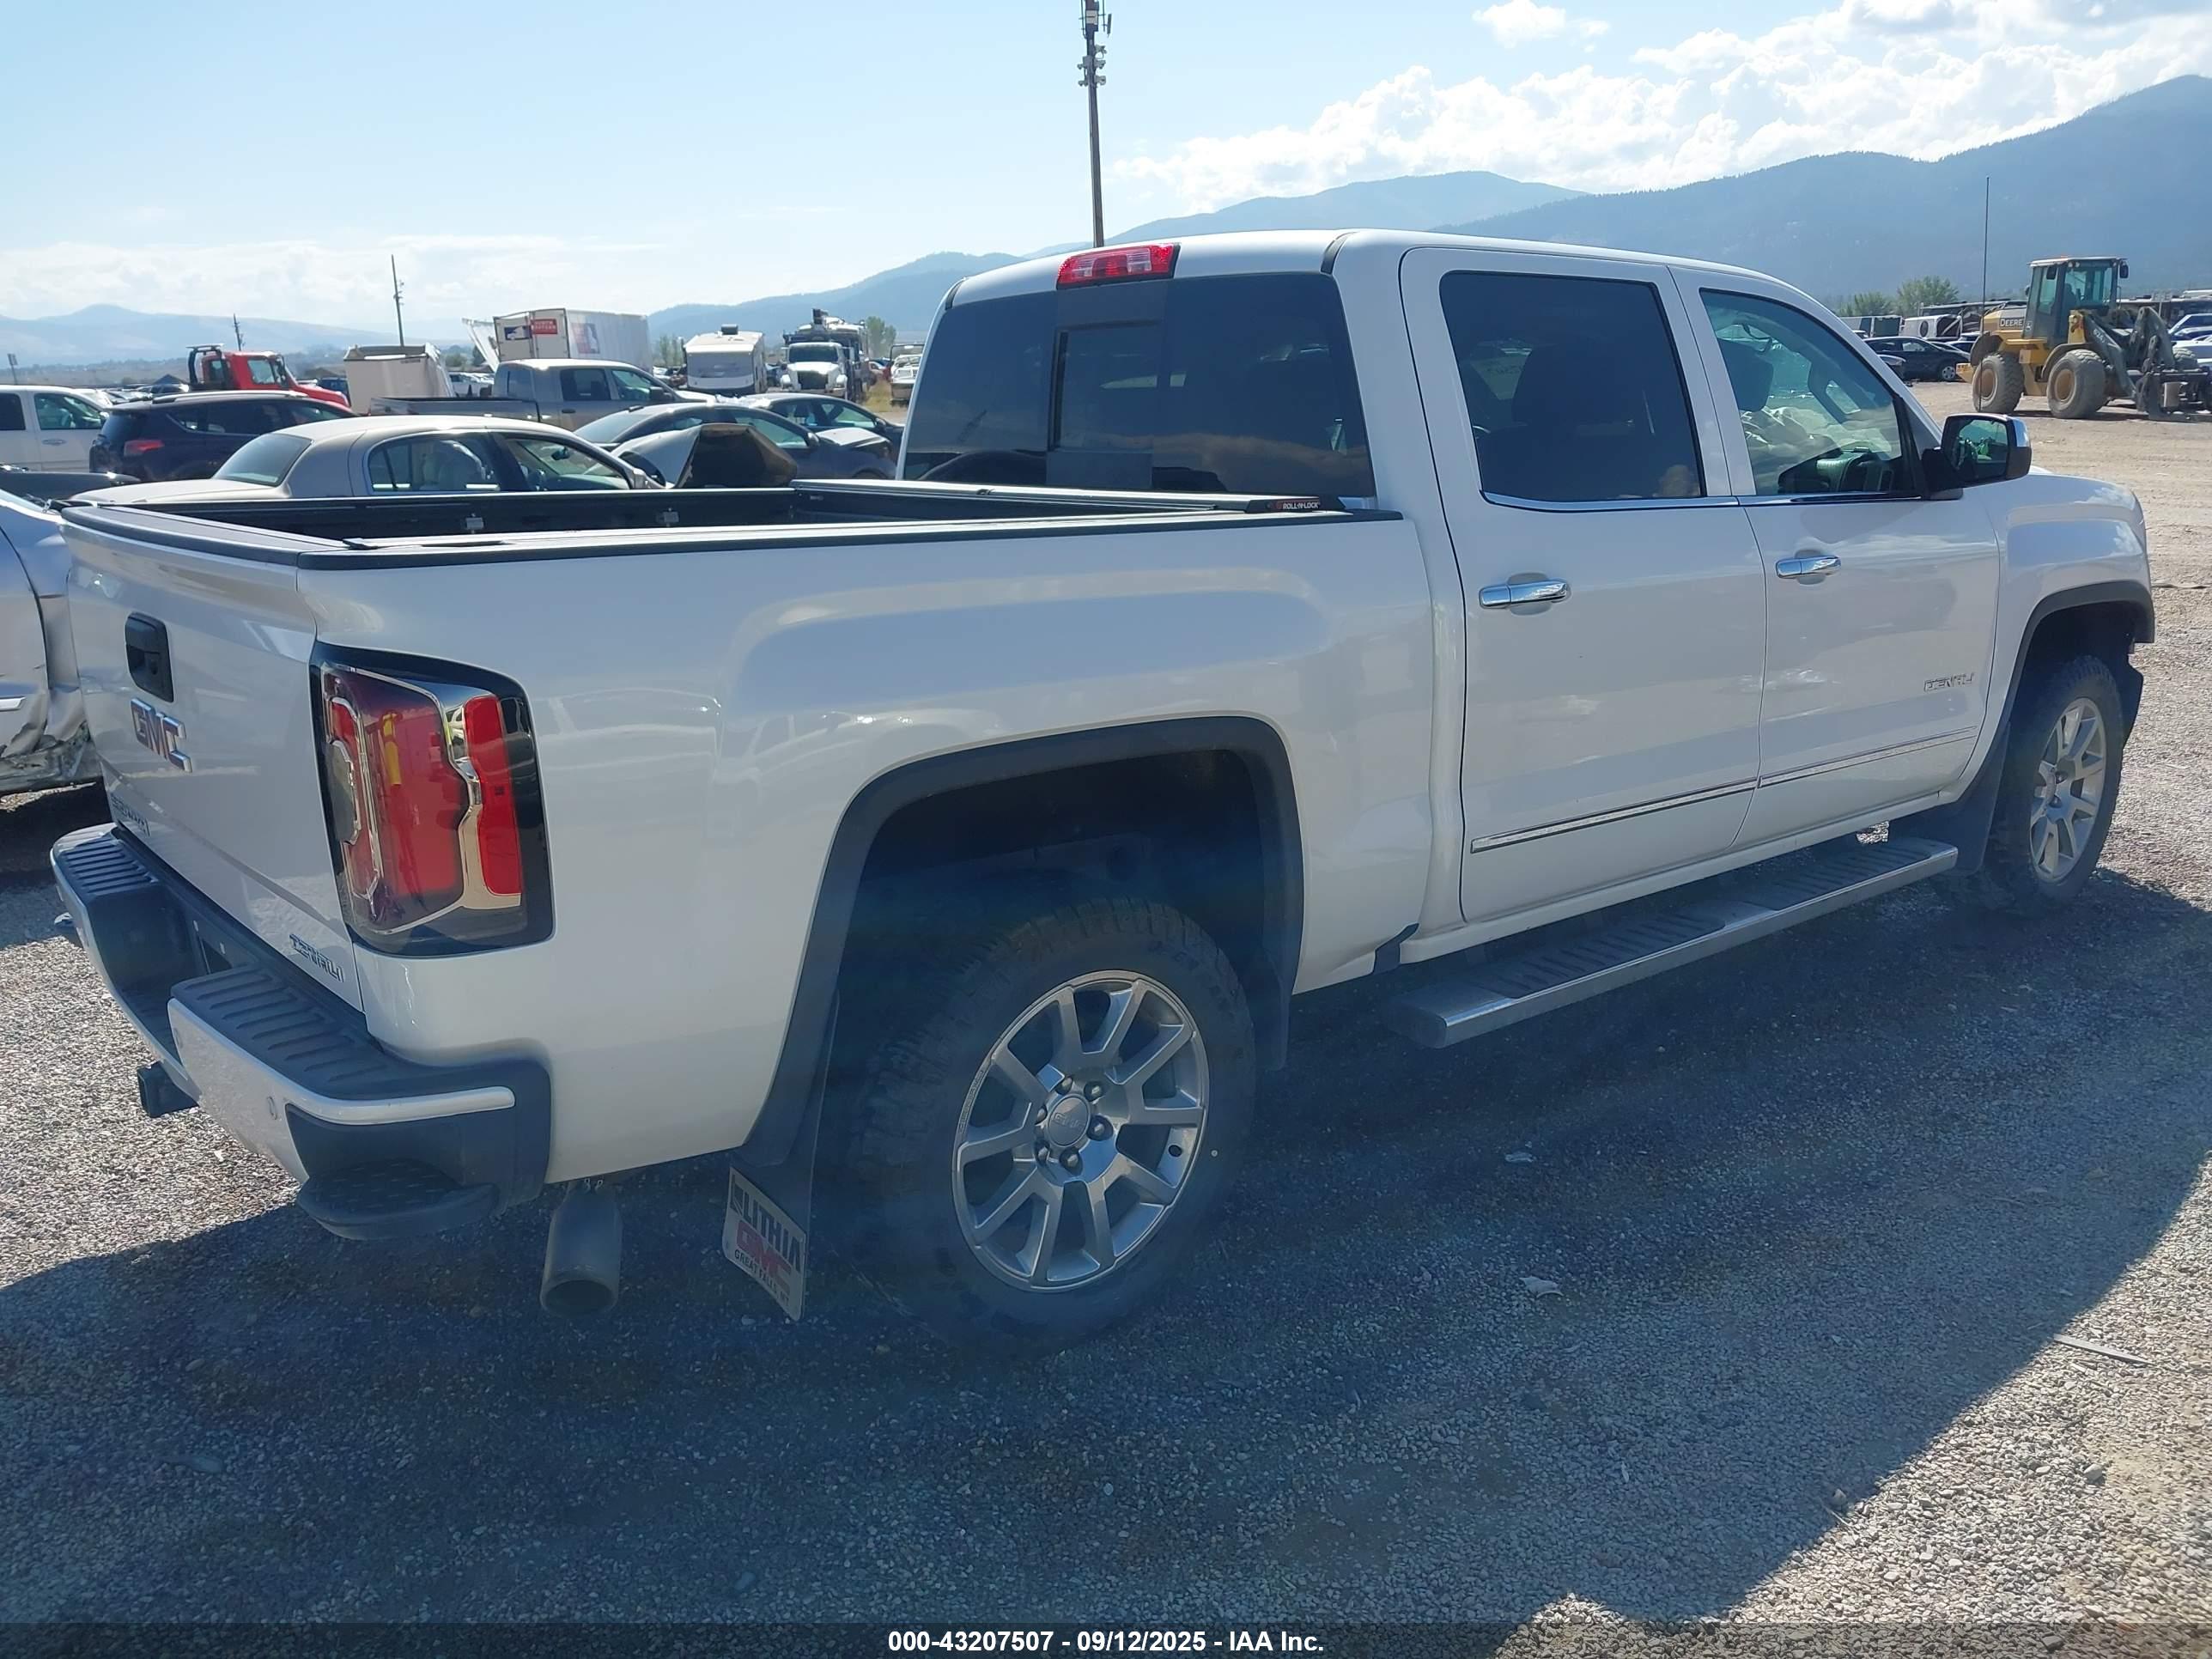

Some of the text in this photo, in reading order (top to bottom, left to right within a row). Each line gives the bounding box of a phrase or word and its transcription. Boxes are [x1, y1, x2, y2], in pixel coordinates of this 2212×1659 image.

[1999, 319, 2024, 328] DEERE
[1923, 672, 1975, 692] DENALI
[131, 697, 192, 773] GMC
[289, 933, 344, 983] DENALI
[744, 1191, 801, 1274] LITHIA
[734, 1249, 758, 1277] GREAT
